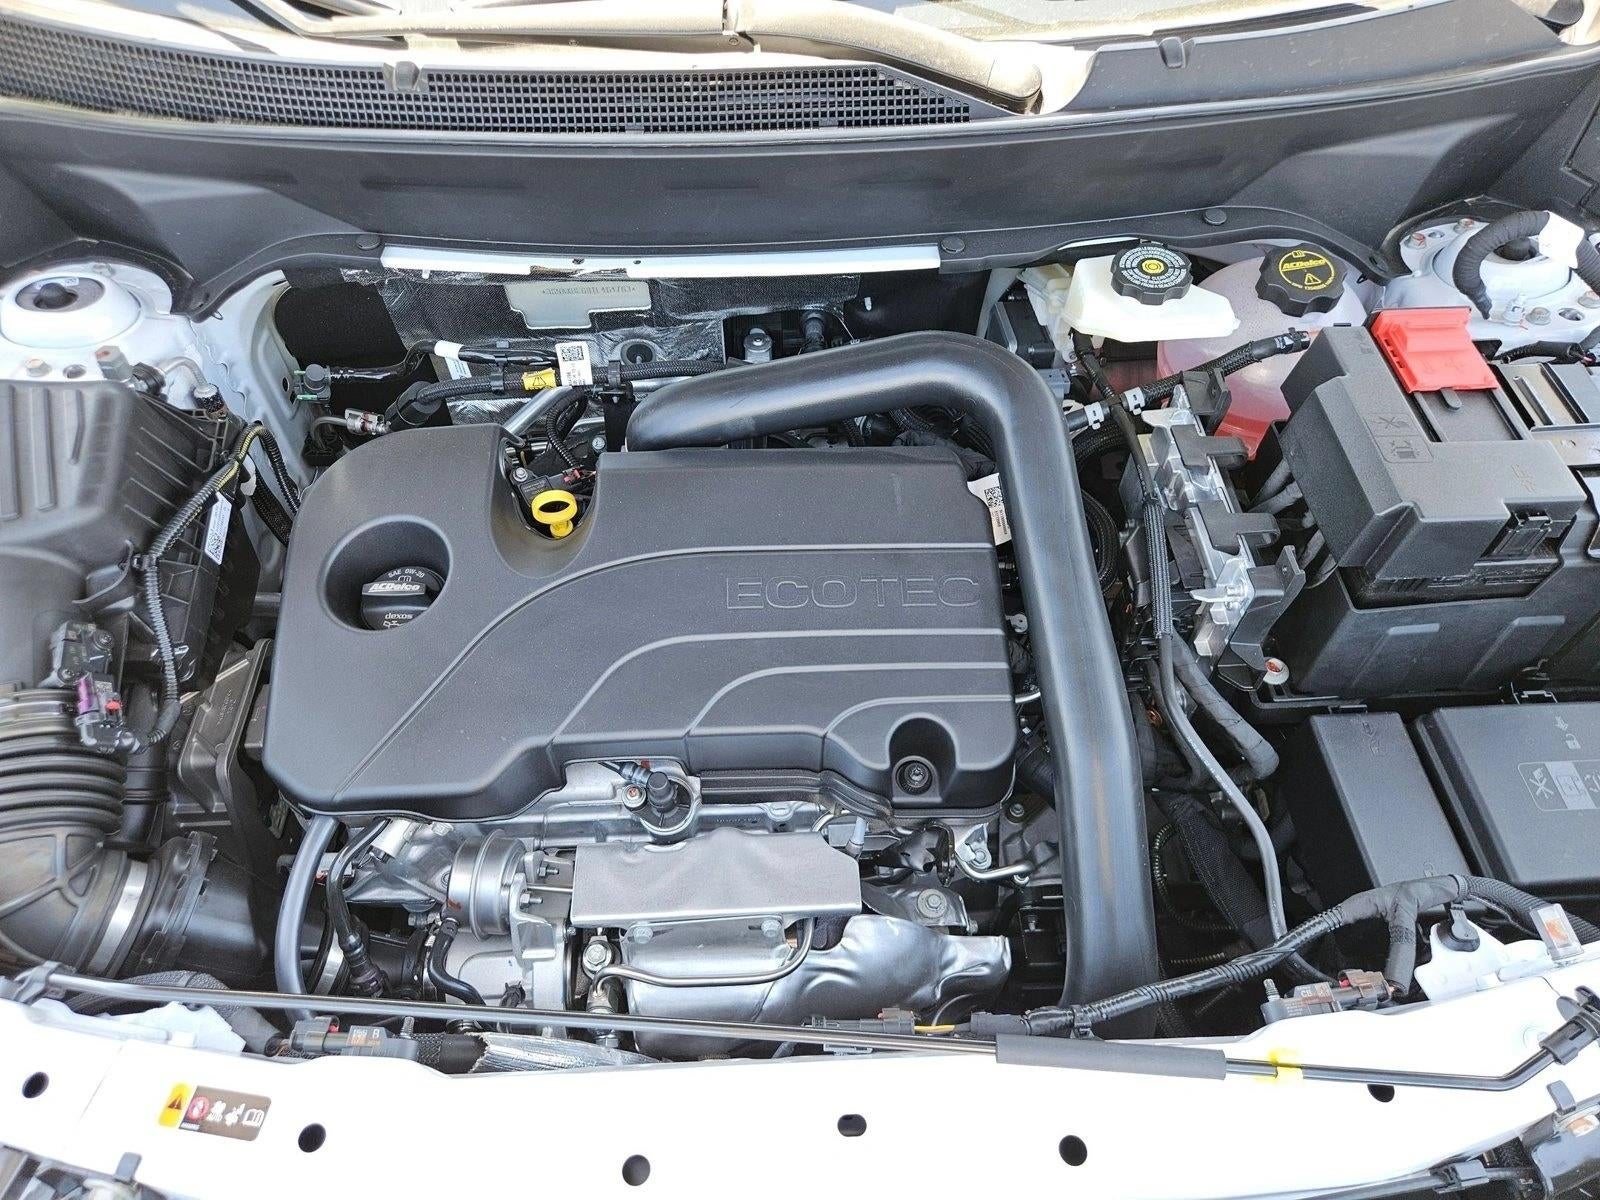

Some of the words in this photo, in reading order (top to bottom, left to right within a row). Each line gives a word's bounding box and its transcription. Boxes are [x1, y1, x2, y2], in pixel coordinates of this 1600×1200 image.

[1281, 259, 1326, 271] ACDelco
[368, 583, 420, 592] ACDelco
[727, 575, 981, 609] ECOTEC
